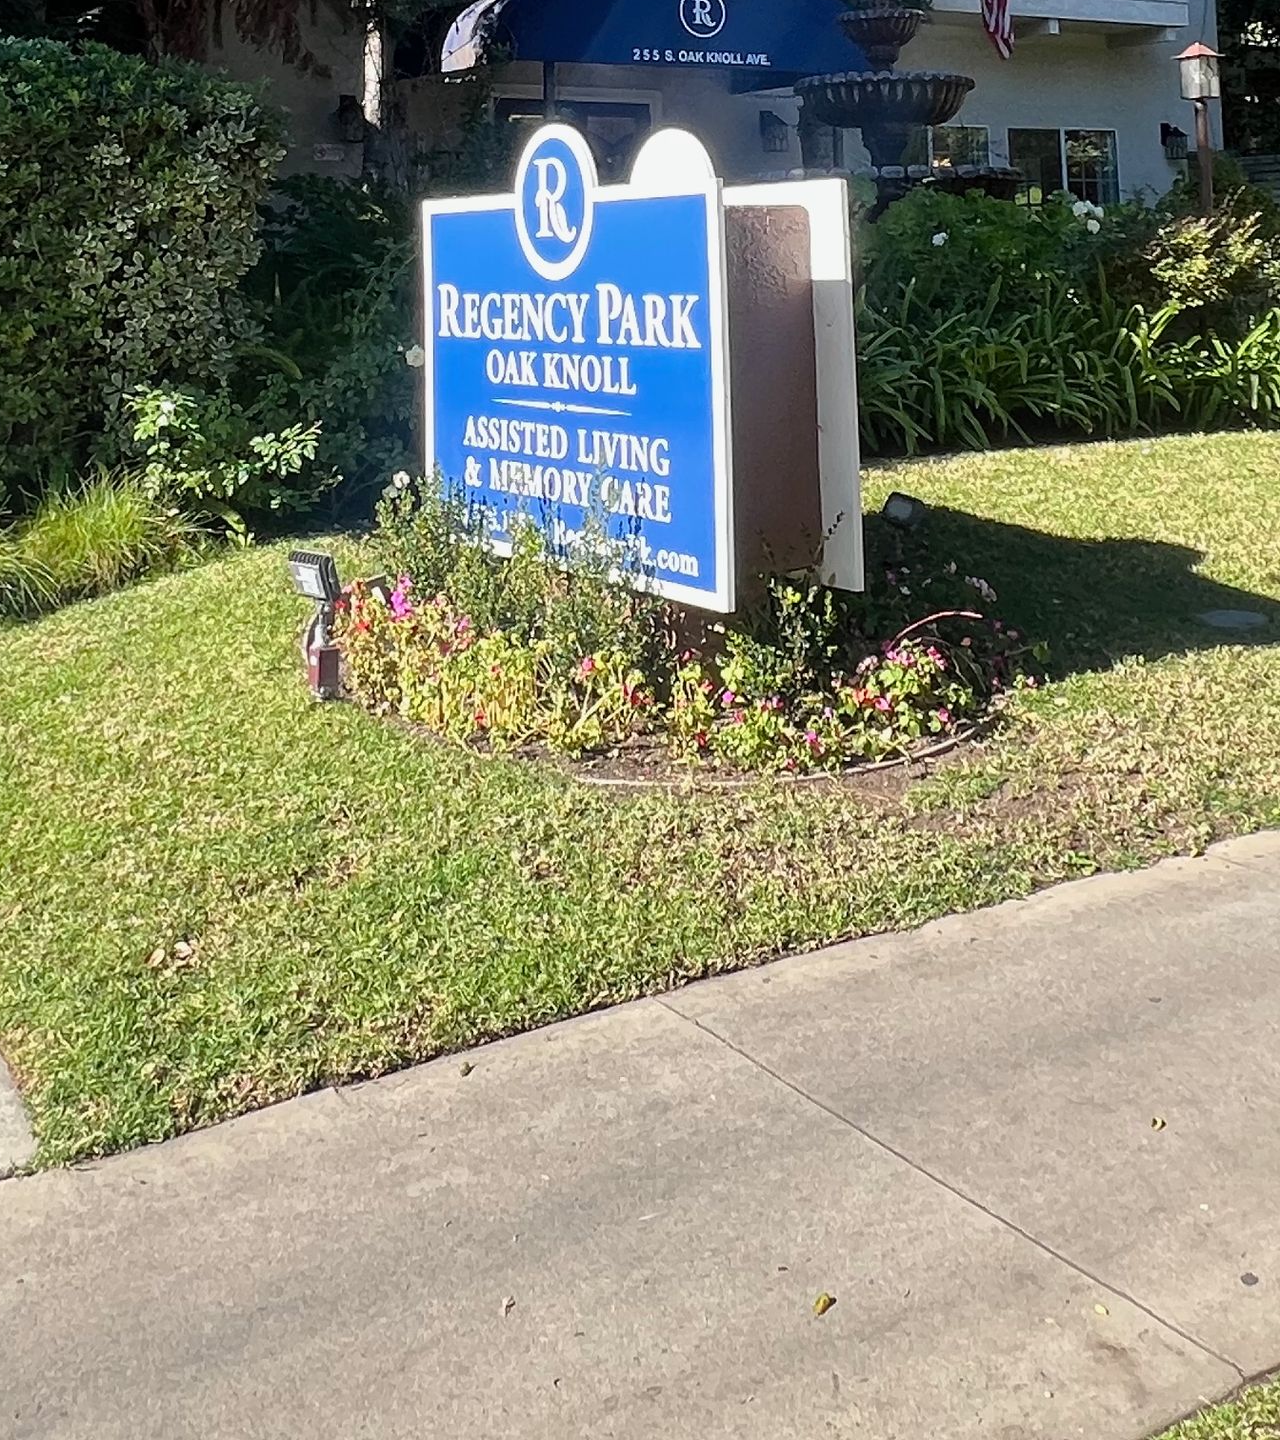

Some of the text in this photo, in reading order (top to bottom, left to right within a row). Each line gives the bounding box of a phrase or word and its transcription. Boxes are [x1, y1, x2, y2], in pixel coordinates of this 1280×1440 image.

[632, 48, 771, 66] 255 S. OAK KNOLL AVE.
[533, 157, 577, 243] R
[437, 282, 701, 349] REGENCY PARK
[486, 348, 636, 395] OAK KNOLL
[463, 415, 671, 476] ASSISTED LIVING
[464, 456, 483, 488] &
[488, 458, 593, 508] MEMORY
[601, 475, 672, 524] CARE
